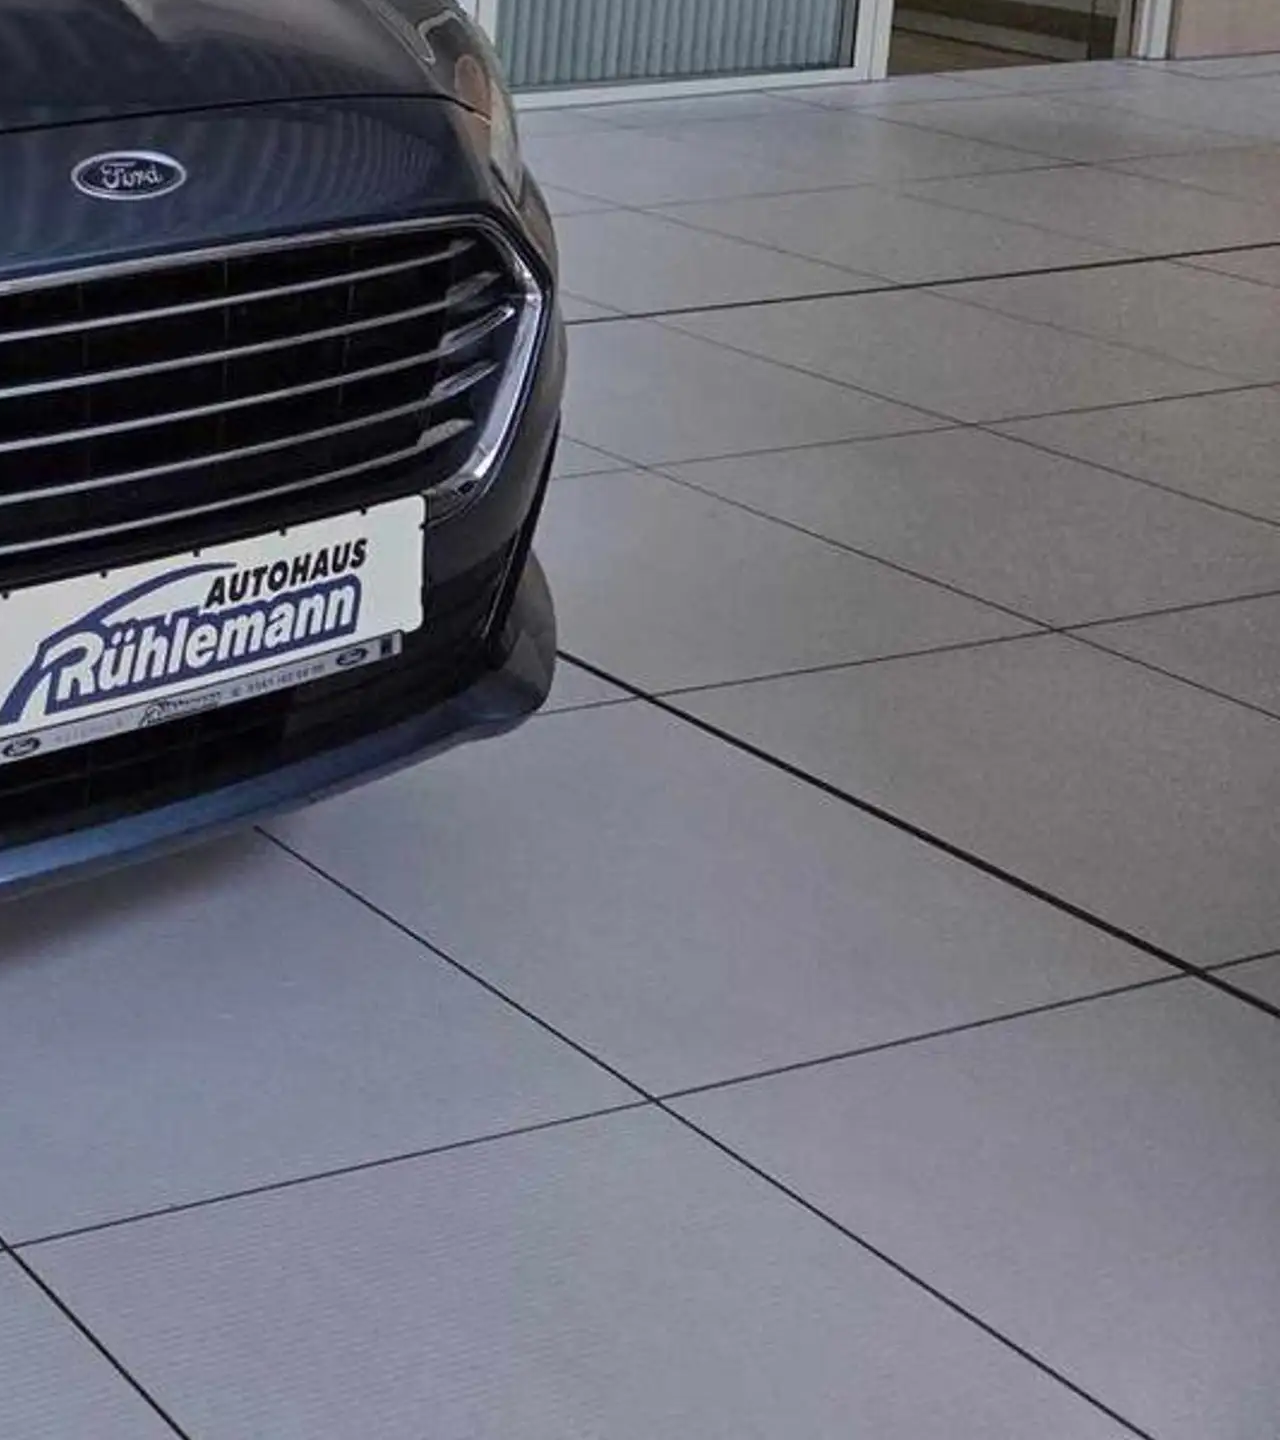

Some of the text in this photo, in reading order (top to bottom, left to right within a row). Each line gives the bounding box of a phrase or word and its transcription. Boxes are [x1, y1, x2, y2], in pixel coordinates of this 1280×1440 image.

[100, 161, 163, 189] Ford
[204, 538, 368, 608] AUTOHAUS
[41, 584, 356, 702] Rühlemann
